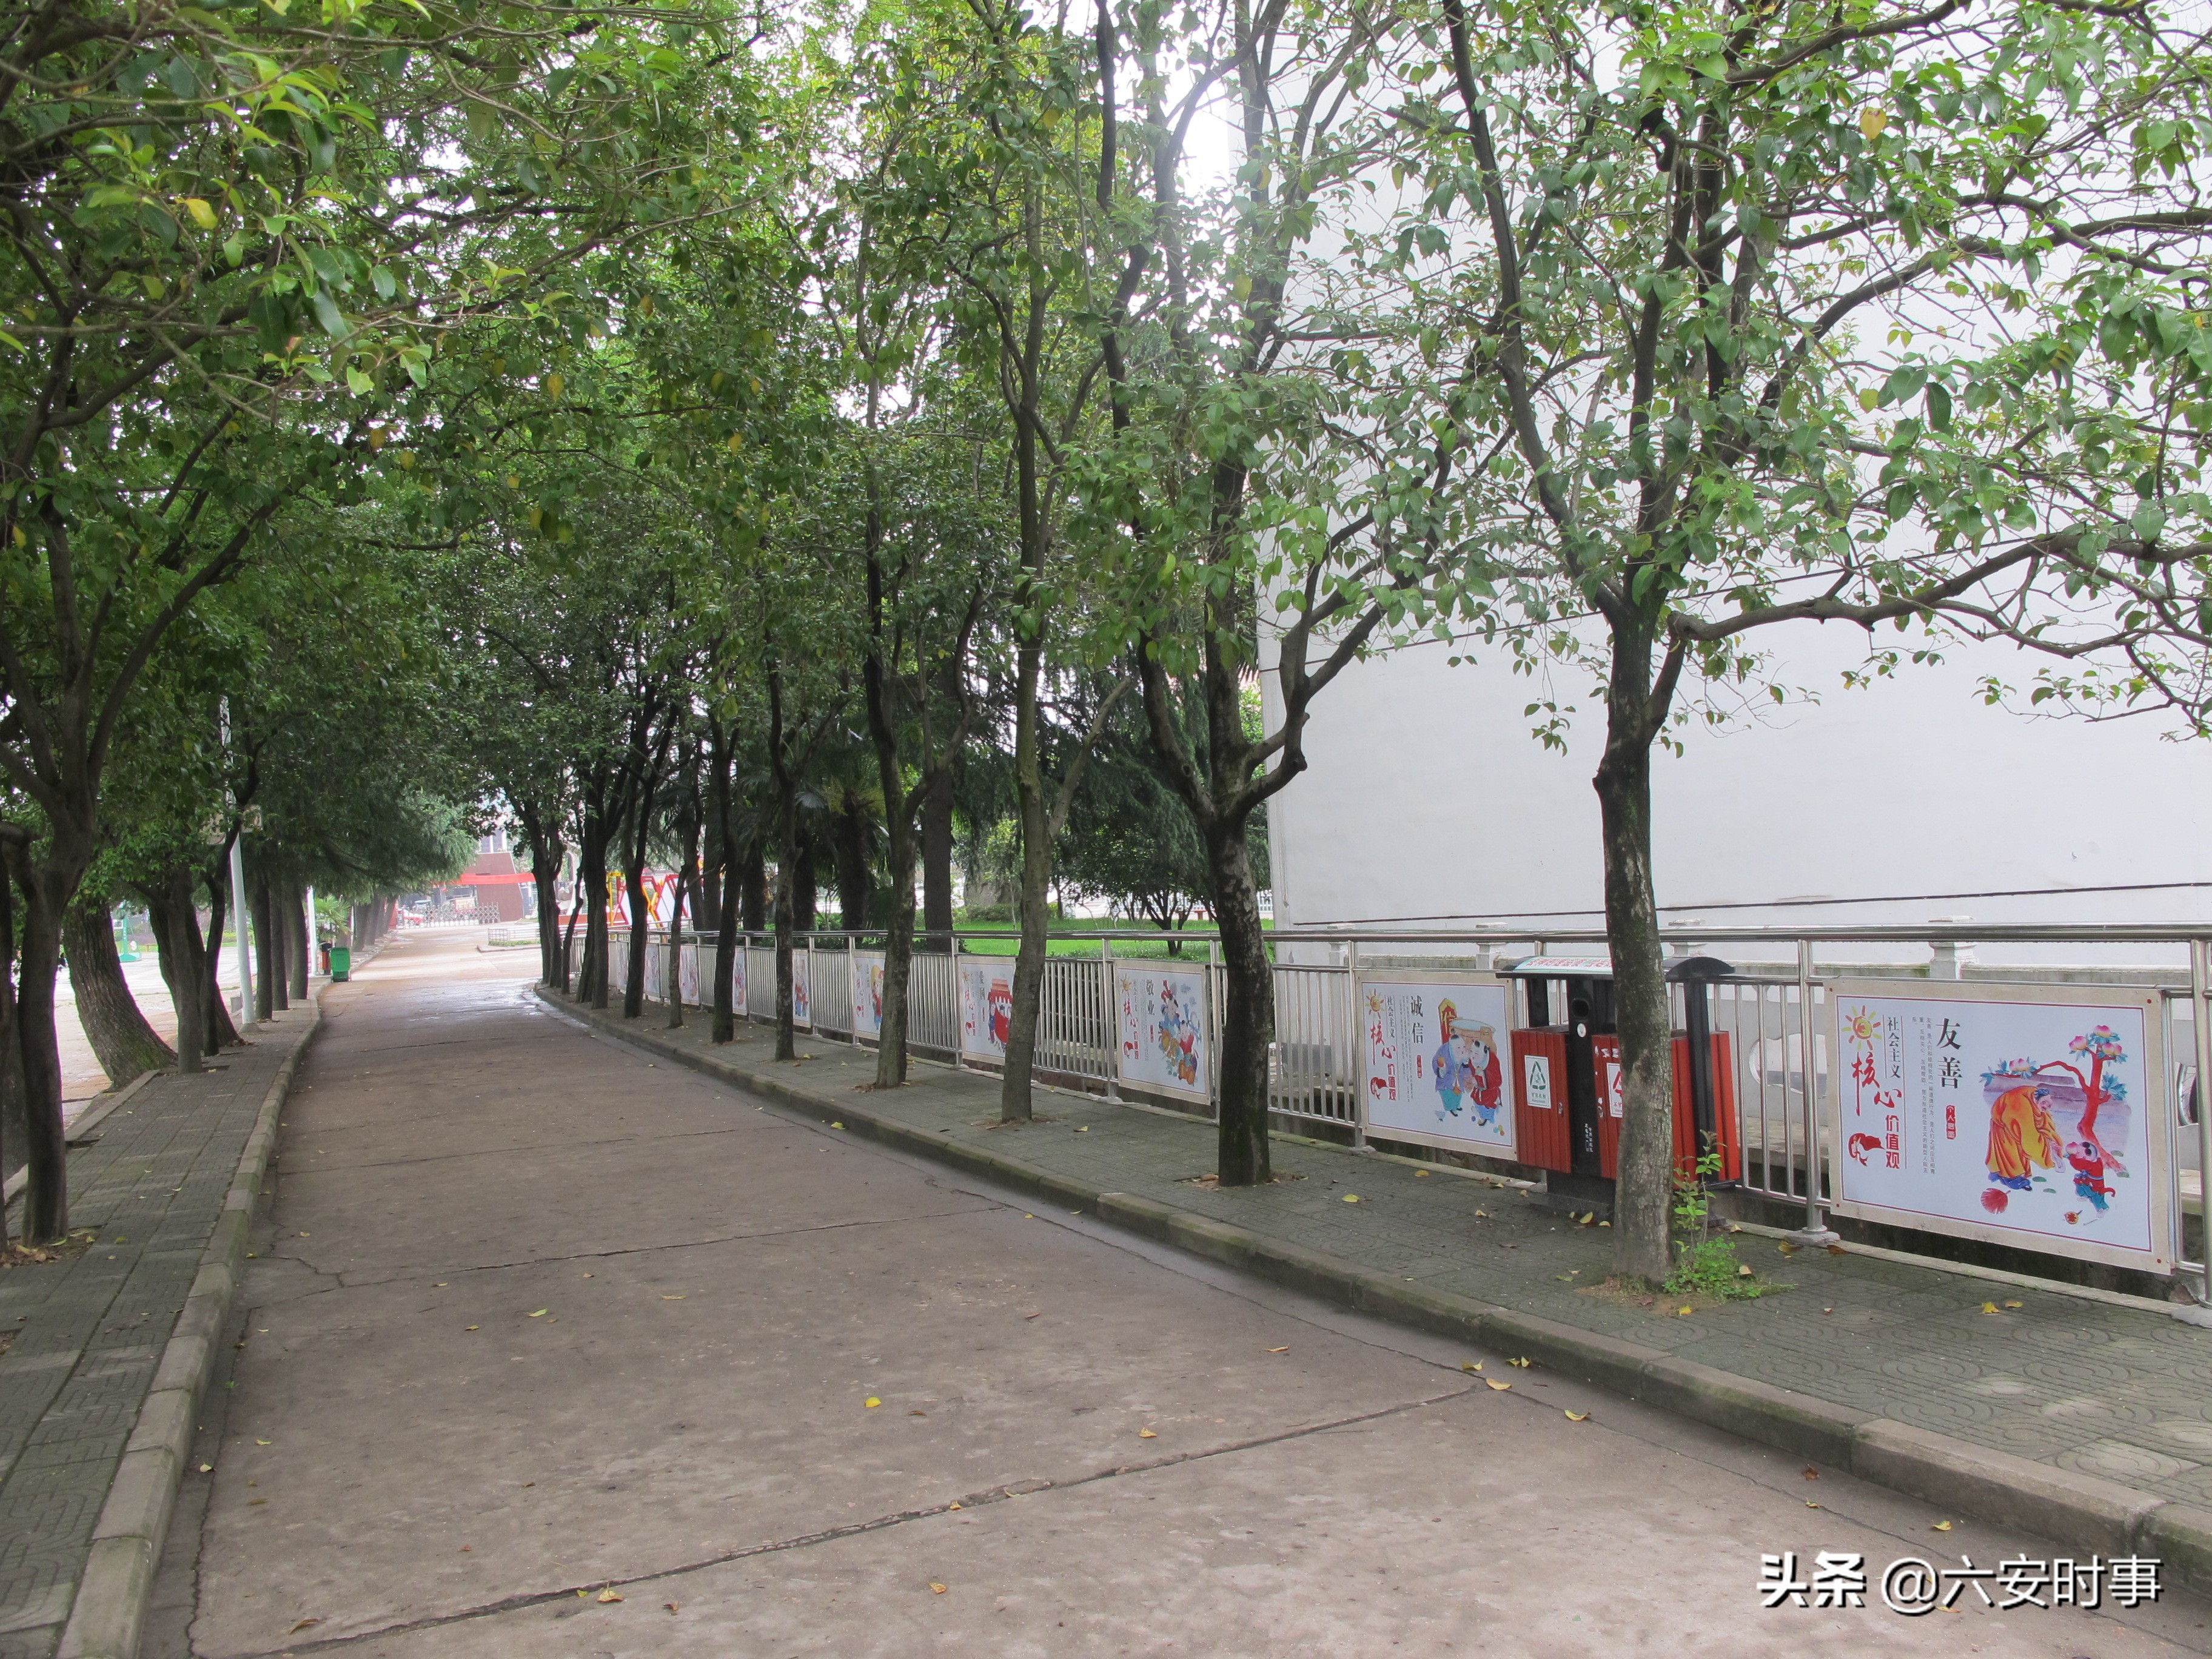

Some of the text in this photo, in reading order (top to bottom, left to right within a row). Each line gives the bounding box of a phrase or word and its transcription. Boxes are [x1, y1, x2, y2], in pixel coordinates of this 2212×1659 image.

[1146, 979, 1155, 1016] 敬业
[1387, 996, 1395, 1038] 社会主义
[1410, 995, 1424, 1044] 诚信
[1887, 1017, 1902, 1079] 社会主义
[1936, 1017, 1963, 1089] 友善
[1886, 1114, 1900, 1169] 价值观
